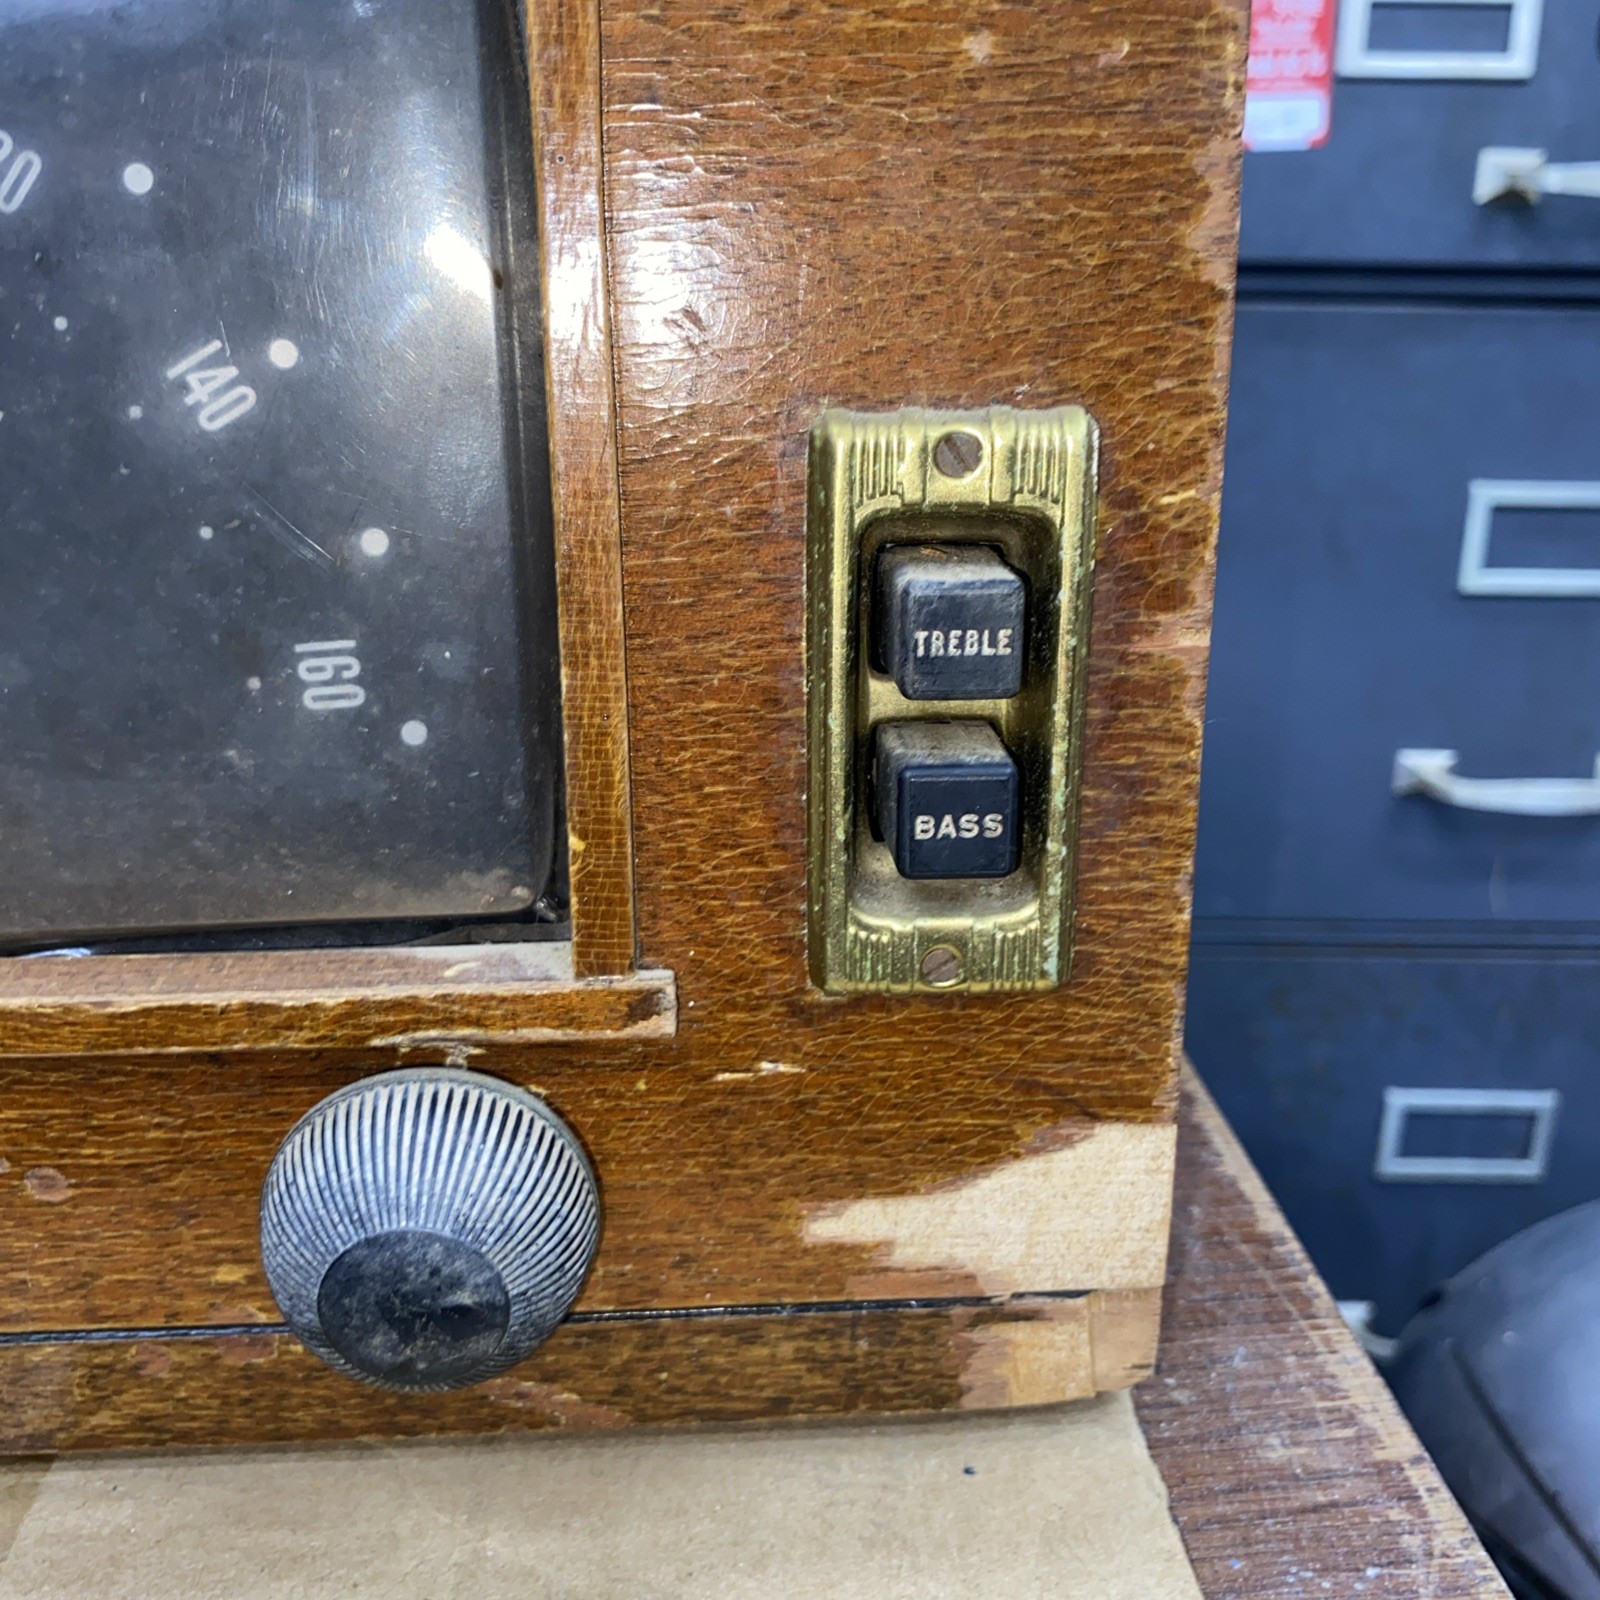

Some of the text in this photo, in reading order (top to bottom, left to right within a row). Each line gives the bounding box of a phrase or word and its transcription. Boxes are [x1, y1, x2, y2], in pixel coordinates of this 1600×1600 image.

[166, 339, 257, 431] 140
[913, 628, 1013, 658] TREBLE
[294, 639, 365, 711] 160
[914, 813, 1004, 840] BASS
